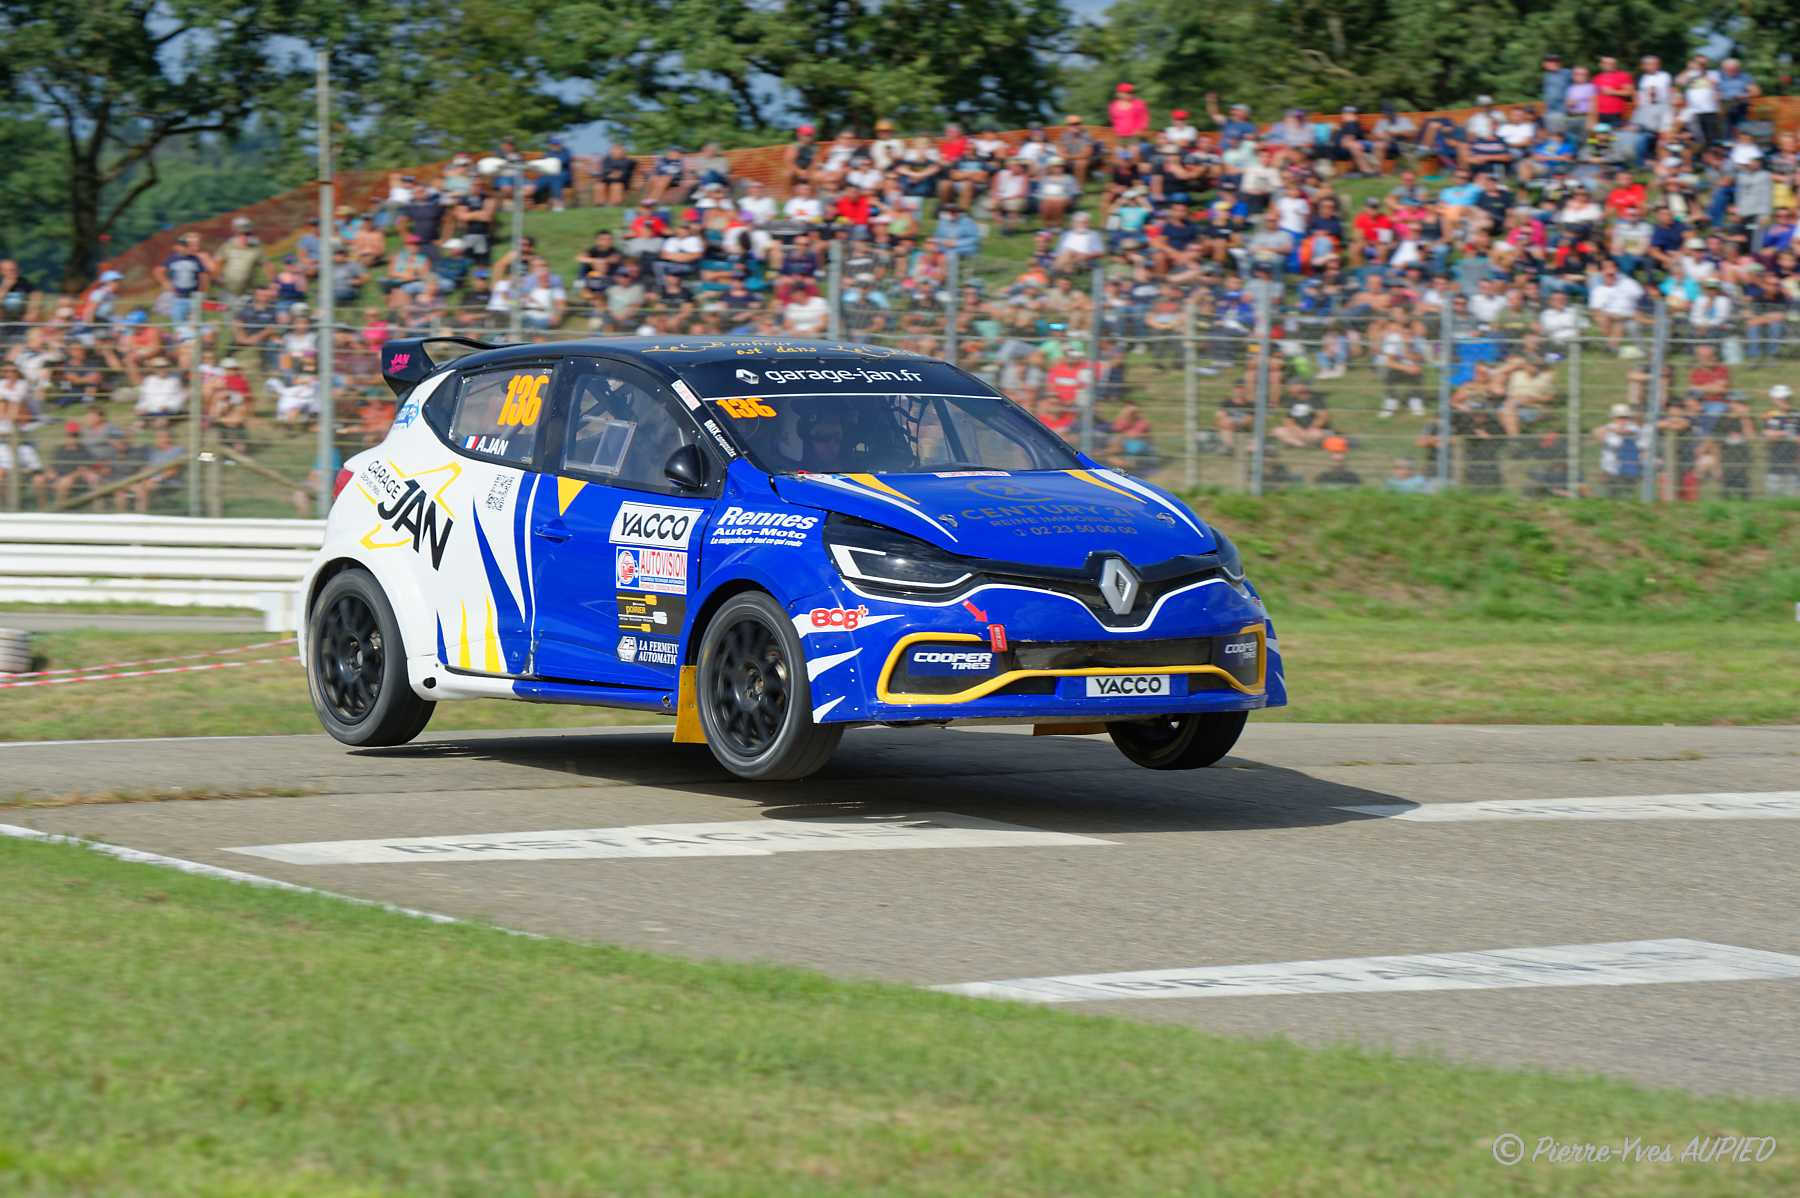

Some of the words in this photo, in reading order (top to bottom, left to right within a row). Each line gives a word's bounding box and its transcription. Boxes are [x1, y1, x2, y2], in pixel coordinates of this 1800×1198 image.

[765, 367, 922, 384] garage-jan.fr
[497, 375, 550, 427] 136
[715, 397, 777, 419] 136
[475, 436, 509, 456] A.JAN
[368, 460, 401, 500] GARAGE
[717, 506, 819, 530] Rennes
[960, 503, 1099, 520] CENTURY
[377, 479, 454, 572] JAN
[621, 512, 689, 541] YACCO
[712, 527, 808, 540] Auto-Moto
[641, 550, 686, 577] AUTOVISION
[639, 640, 648, 651] LA
[914, 652, 993, 663] COOPER
[951, 662, 990, 670] TIRES
[1095, 677, 1162, 694] YACCO
